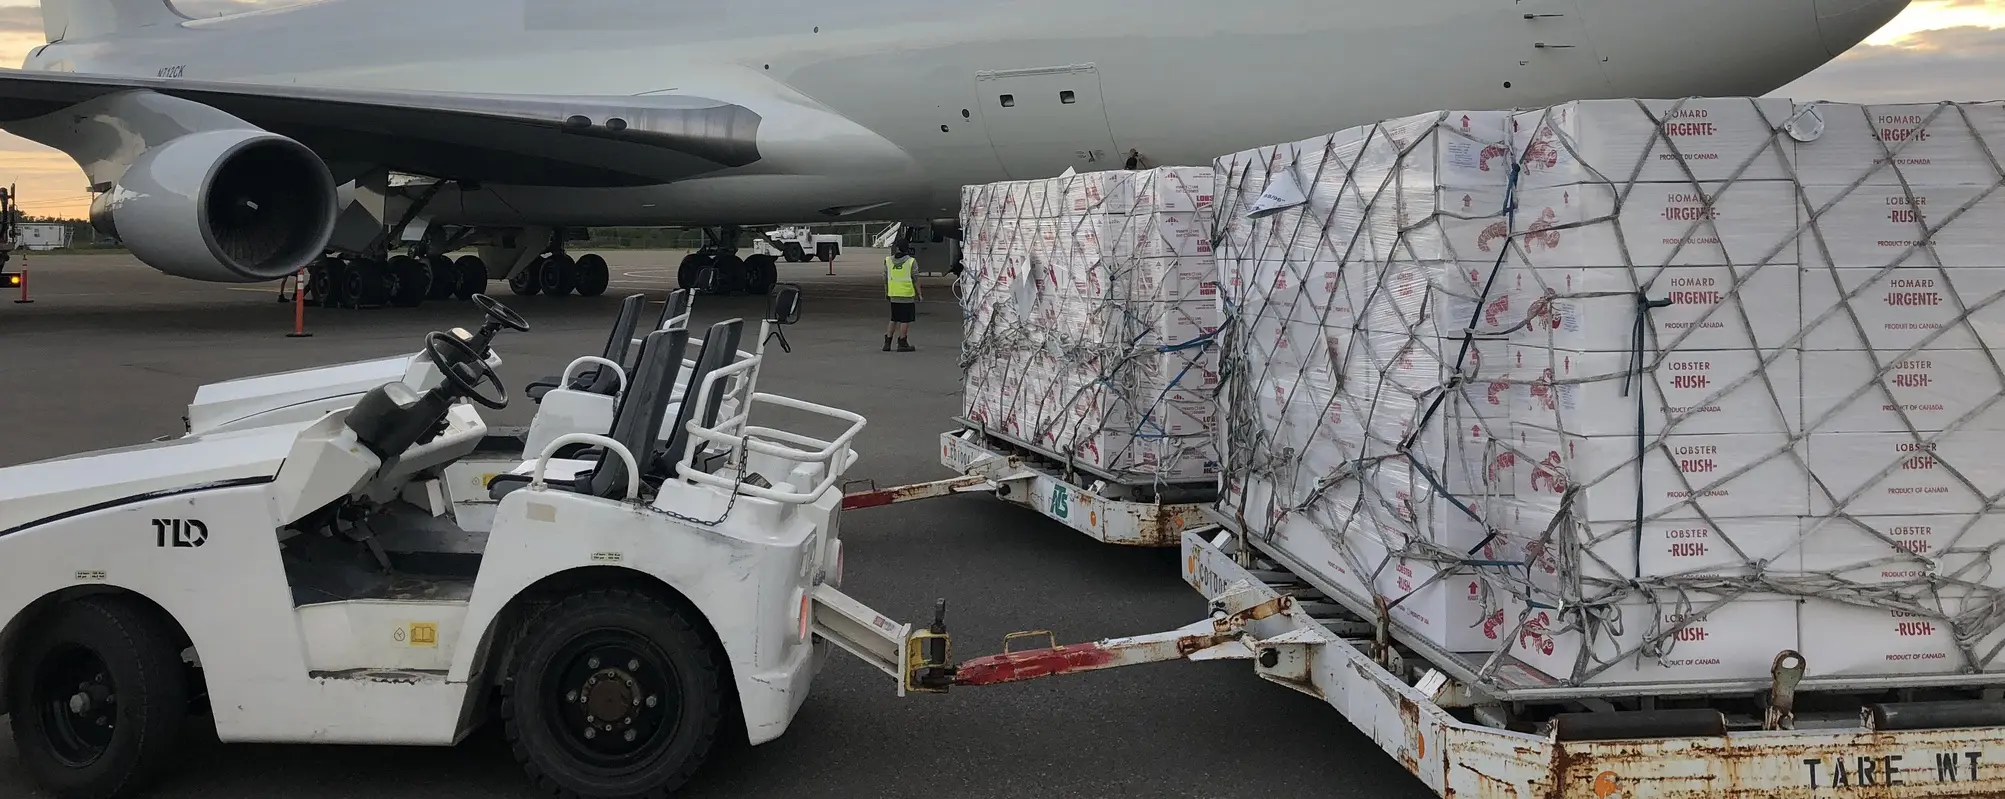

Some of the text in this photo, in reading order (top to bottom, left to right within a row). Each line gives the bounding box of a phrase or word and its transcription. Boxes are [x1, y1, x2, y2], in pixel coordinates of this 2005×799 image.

[1878, 115, 1922, 124] HOMARD
[1885, 196, 1927, 206] LOBSER
[1660, 206, 1721, 221] -URGENE-
[1670, 277, 1715, 287] HOMARD
[1890, 279, 1935, 288] HOMARD
[1883, 292, 1943, 306] -URGENTE-
[1668, 361, 1711, 371] LOBSTER
[1891, 360, 1932, 370] OBSTER
[1669, 374, 1711, 389] -RUSH-
[1891, 373, 1933, 388] -RUSH-
[1674, 445, 1717, 455] LOBSTER
[1923, 486, 1949, 494] CANADA
[151, 518, 209, 548] TLD
[1665, 529, 1708, 539] LOBSTER
[1889, 526, 1932, 536] LOBSTER
[1667, 542, 1709, 557] -RUSH-
[1894, 621, 1936, 636] -RUSH-
[1694, 658, 1721, 666] CANADA
[1803, 751, 1983, 791] TARE WT
